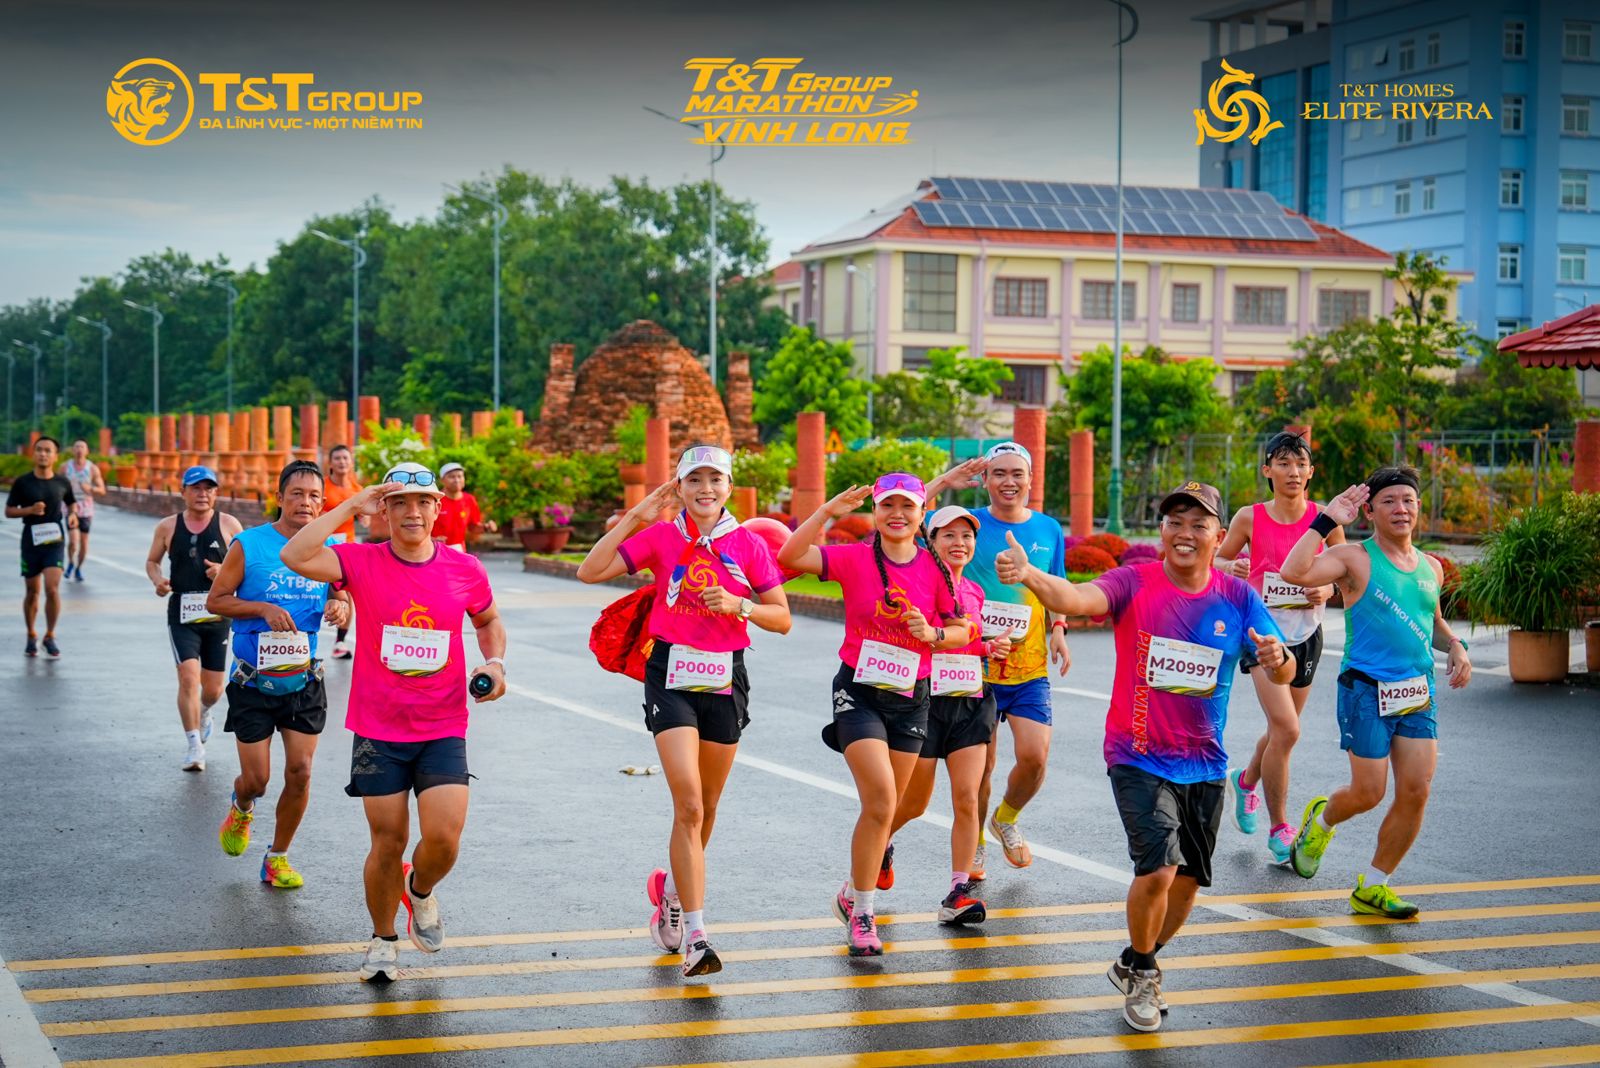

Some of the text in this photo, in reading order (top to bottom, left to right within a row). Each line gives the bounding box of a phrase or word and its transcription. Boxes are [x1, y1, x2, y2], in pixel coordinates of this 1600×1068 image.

[1374, 588, 1391, 605] TAN
[1391, 602, 1409, 622] THOI
[980, 613, 1027, 630] M20373
[260, 645, 309, 655] M20845
[393, 644, 438, 660] P0011
[676, 660, 726, 676] P0009
[867, 657, 910, 678] P0010
[940, 669, 976, 681] P0012
[1149, 656, 1217, 678] M20997
[1380, 684, 1428, 700] M20949
[1132, 685, 1150, 755] WINNER
